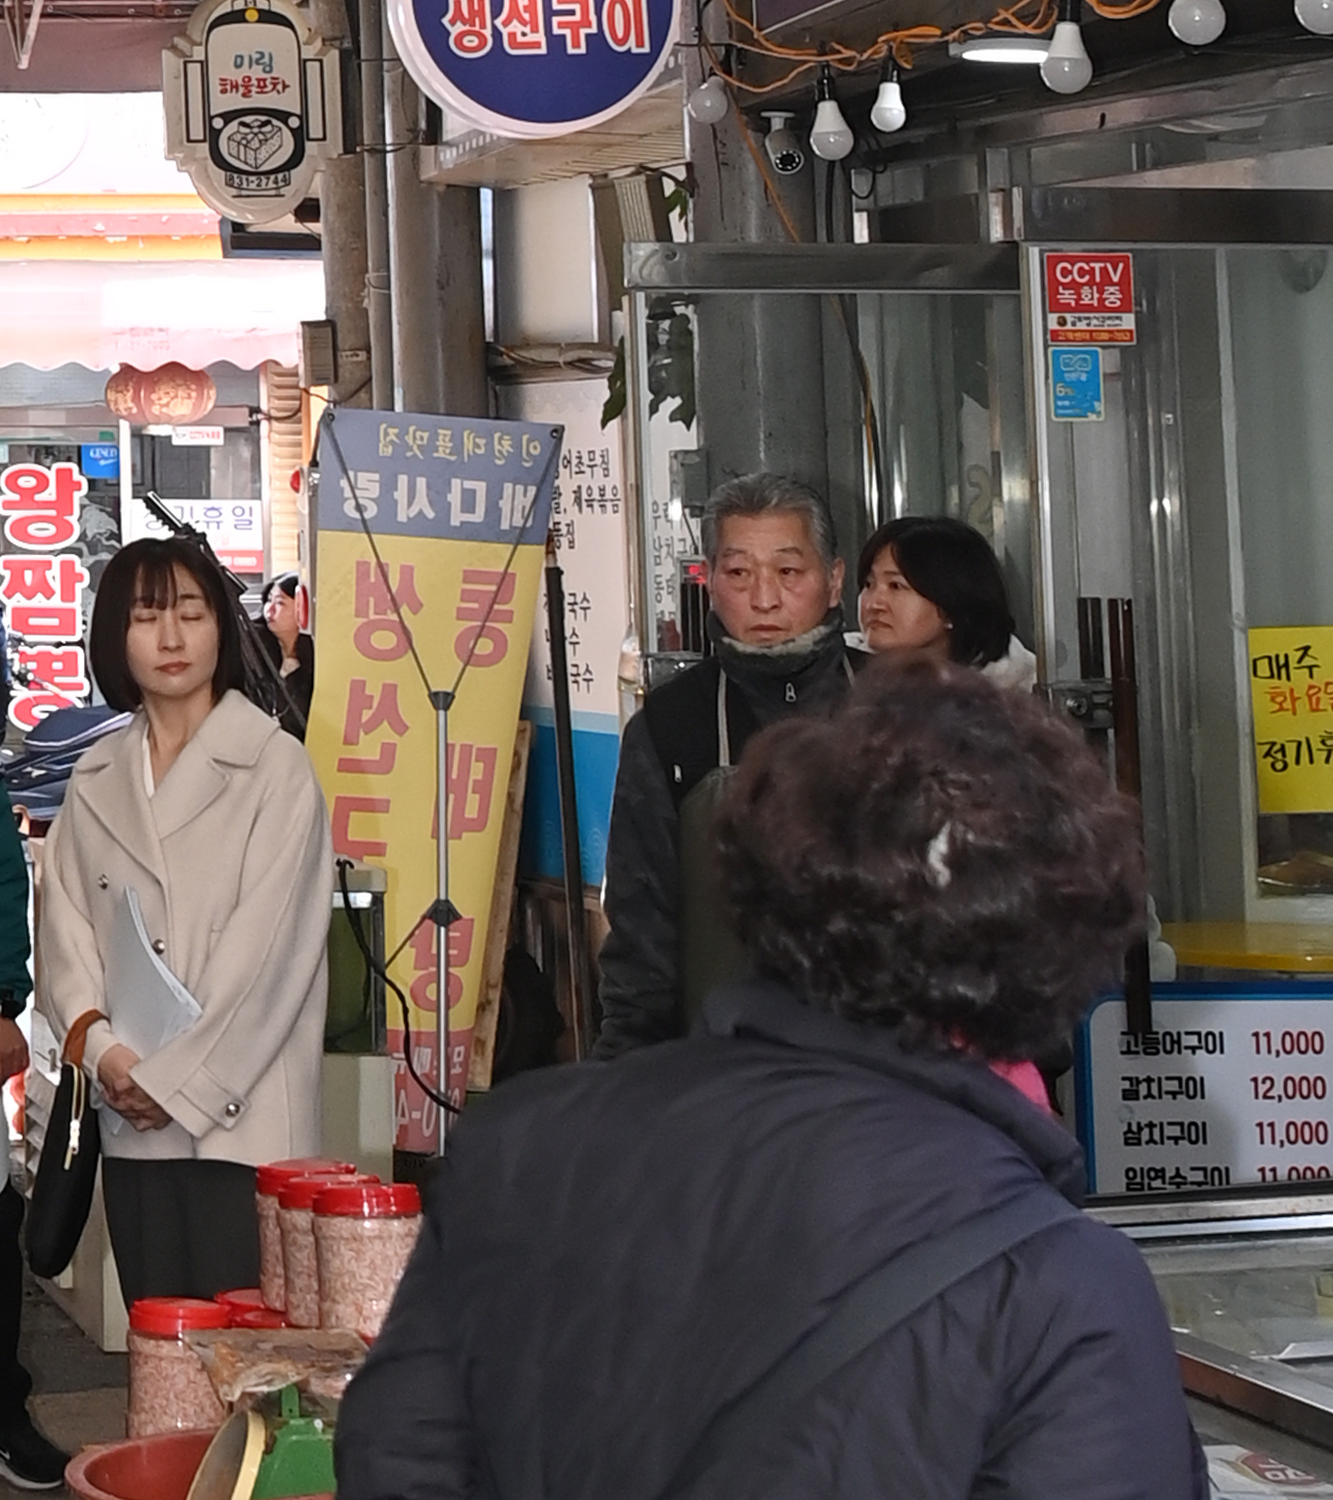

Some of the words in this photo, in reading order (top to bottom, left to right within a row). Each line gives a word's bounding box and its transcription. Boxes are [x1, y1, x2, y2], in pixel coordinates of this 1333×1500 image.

[1055, 261, 1124, 284] CCTV
[554, 447, 611, 480] 어초무침
[1252, 644, 1321, 682] 매주
[1119, 1029, 1225, 1058] 고등어구이
[1251, 1030, 1325, 1060] 11,000
[1120, 1075, 1206, 1103] 갈치구이
[1250, 1075, 1327, 1104] 12,000
[1123, 1120, 1208, 1148] 삼치구이
[1256, 1120, 1329, 1149] 11,000
[1124, 1165, 1231, 1193] 임연수구이
[1257, 1165, 1332, 1184] 11000
